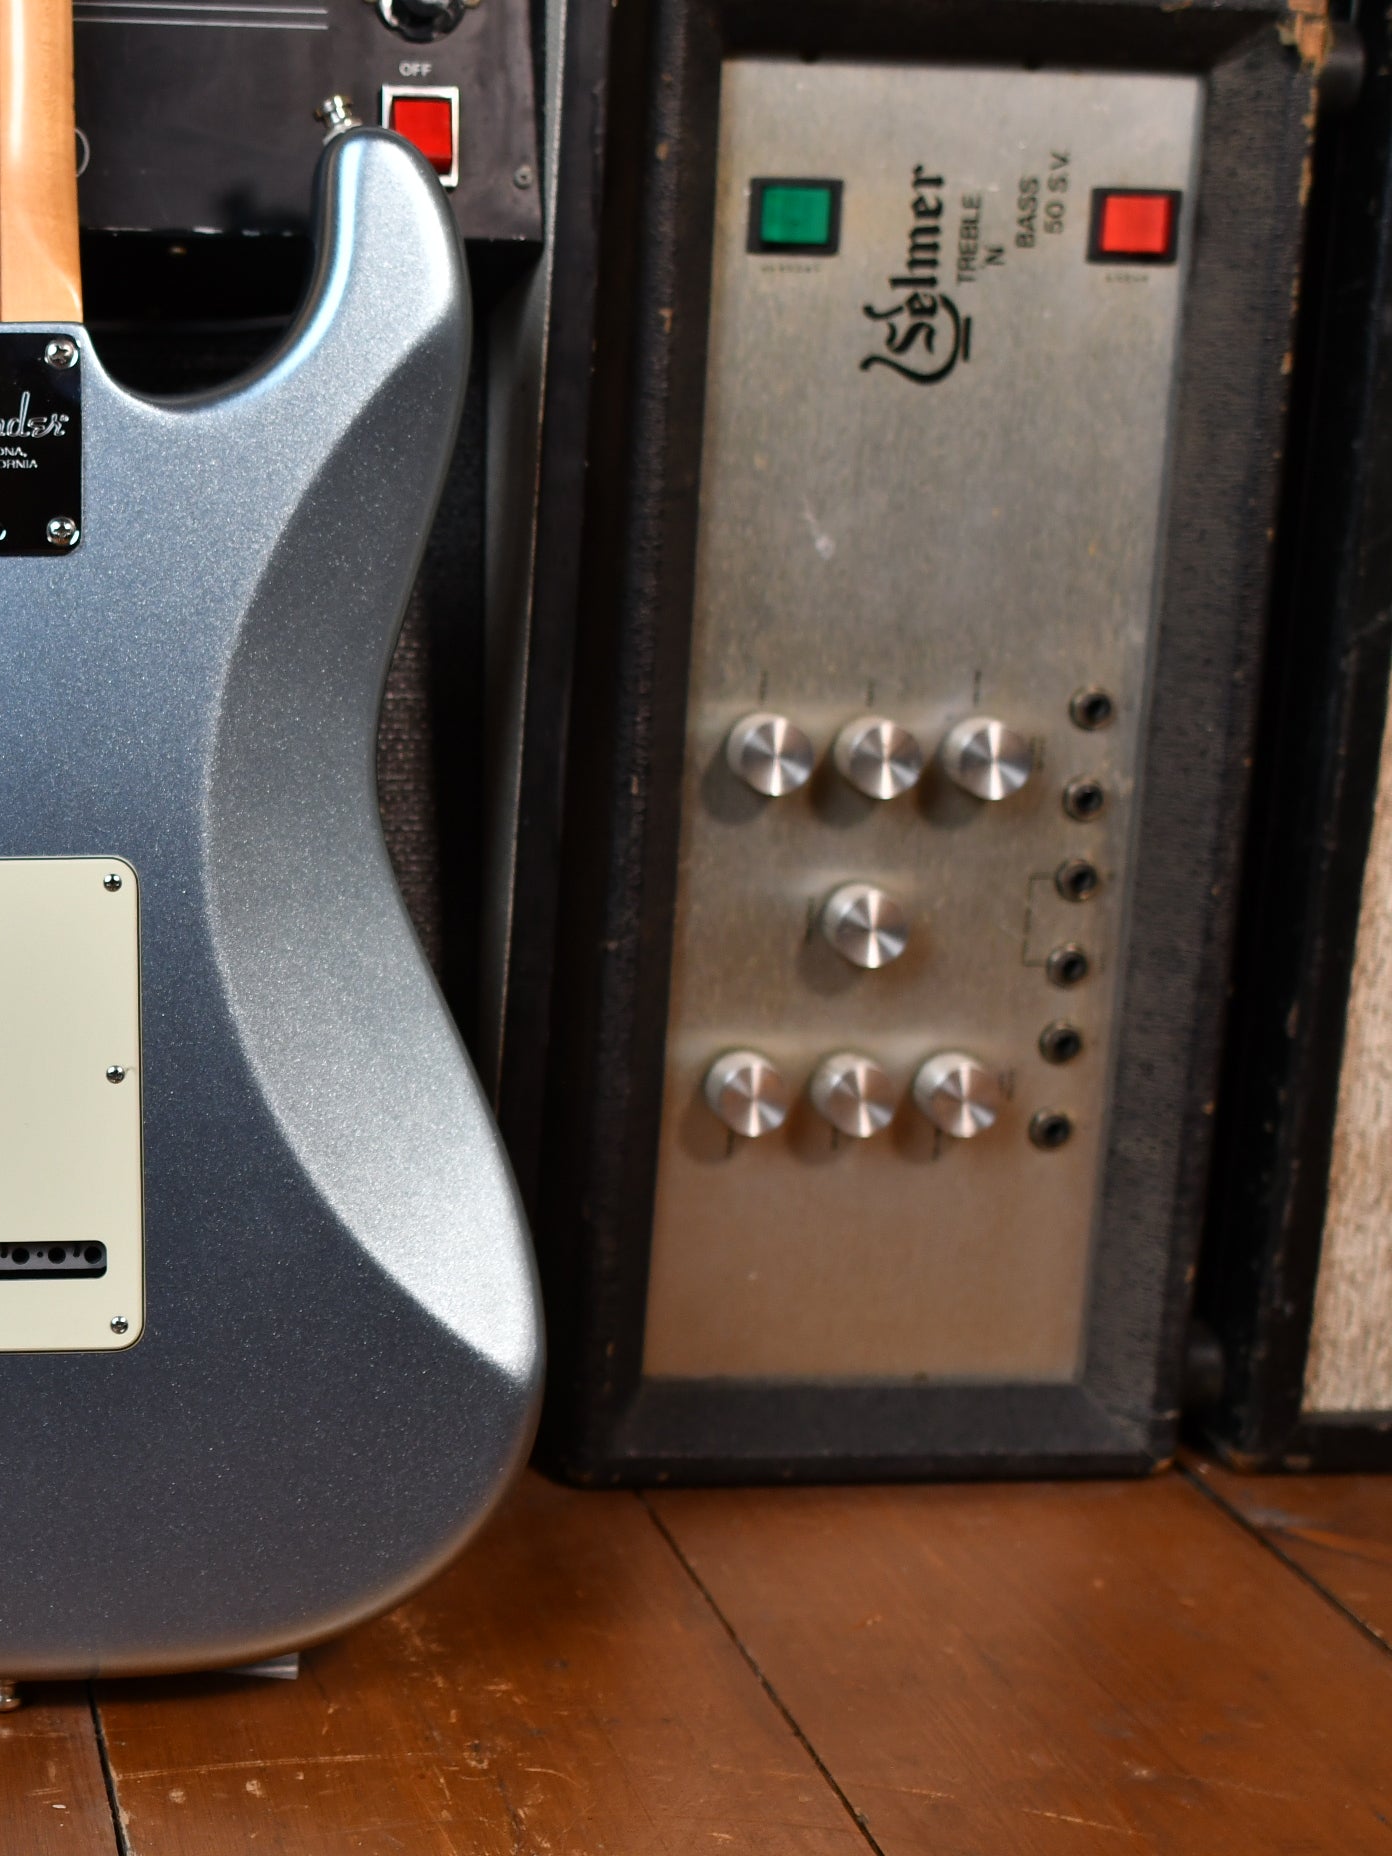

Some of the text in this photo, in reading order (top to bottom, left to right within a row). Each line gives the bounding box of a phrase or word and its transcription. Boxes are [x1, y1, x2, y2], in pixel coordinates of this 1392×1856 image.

[399, 62, 432, 76] OFF
[956, 193, 982, 287] TREBLE
[1014, 177, 1041, 249] BASS
[1043, 200, 1066, 234] 50
[859, 162, 973, 386] Selmer
